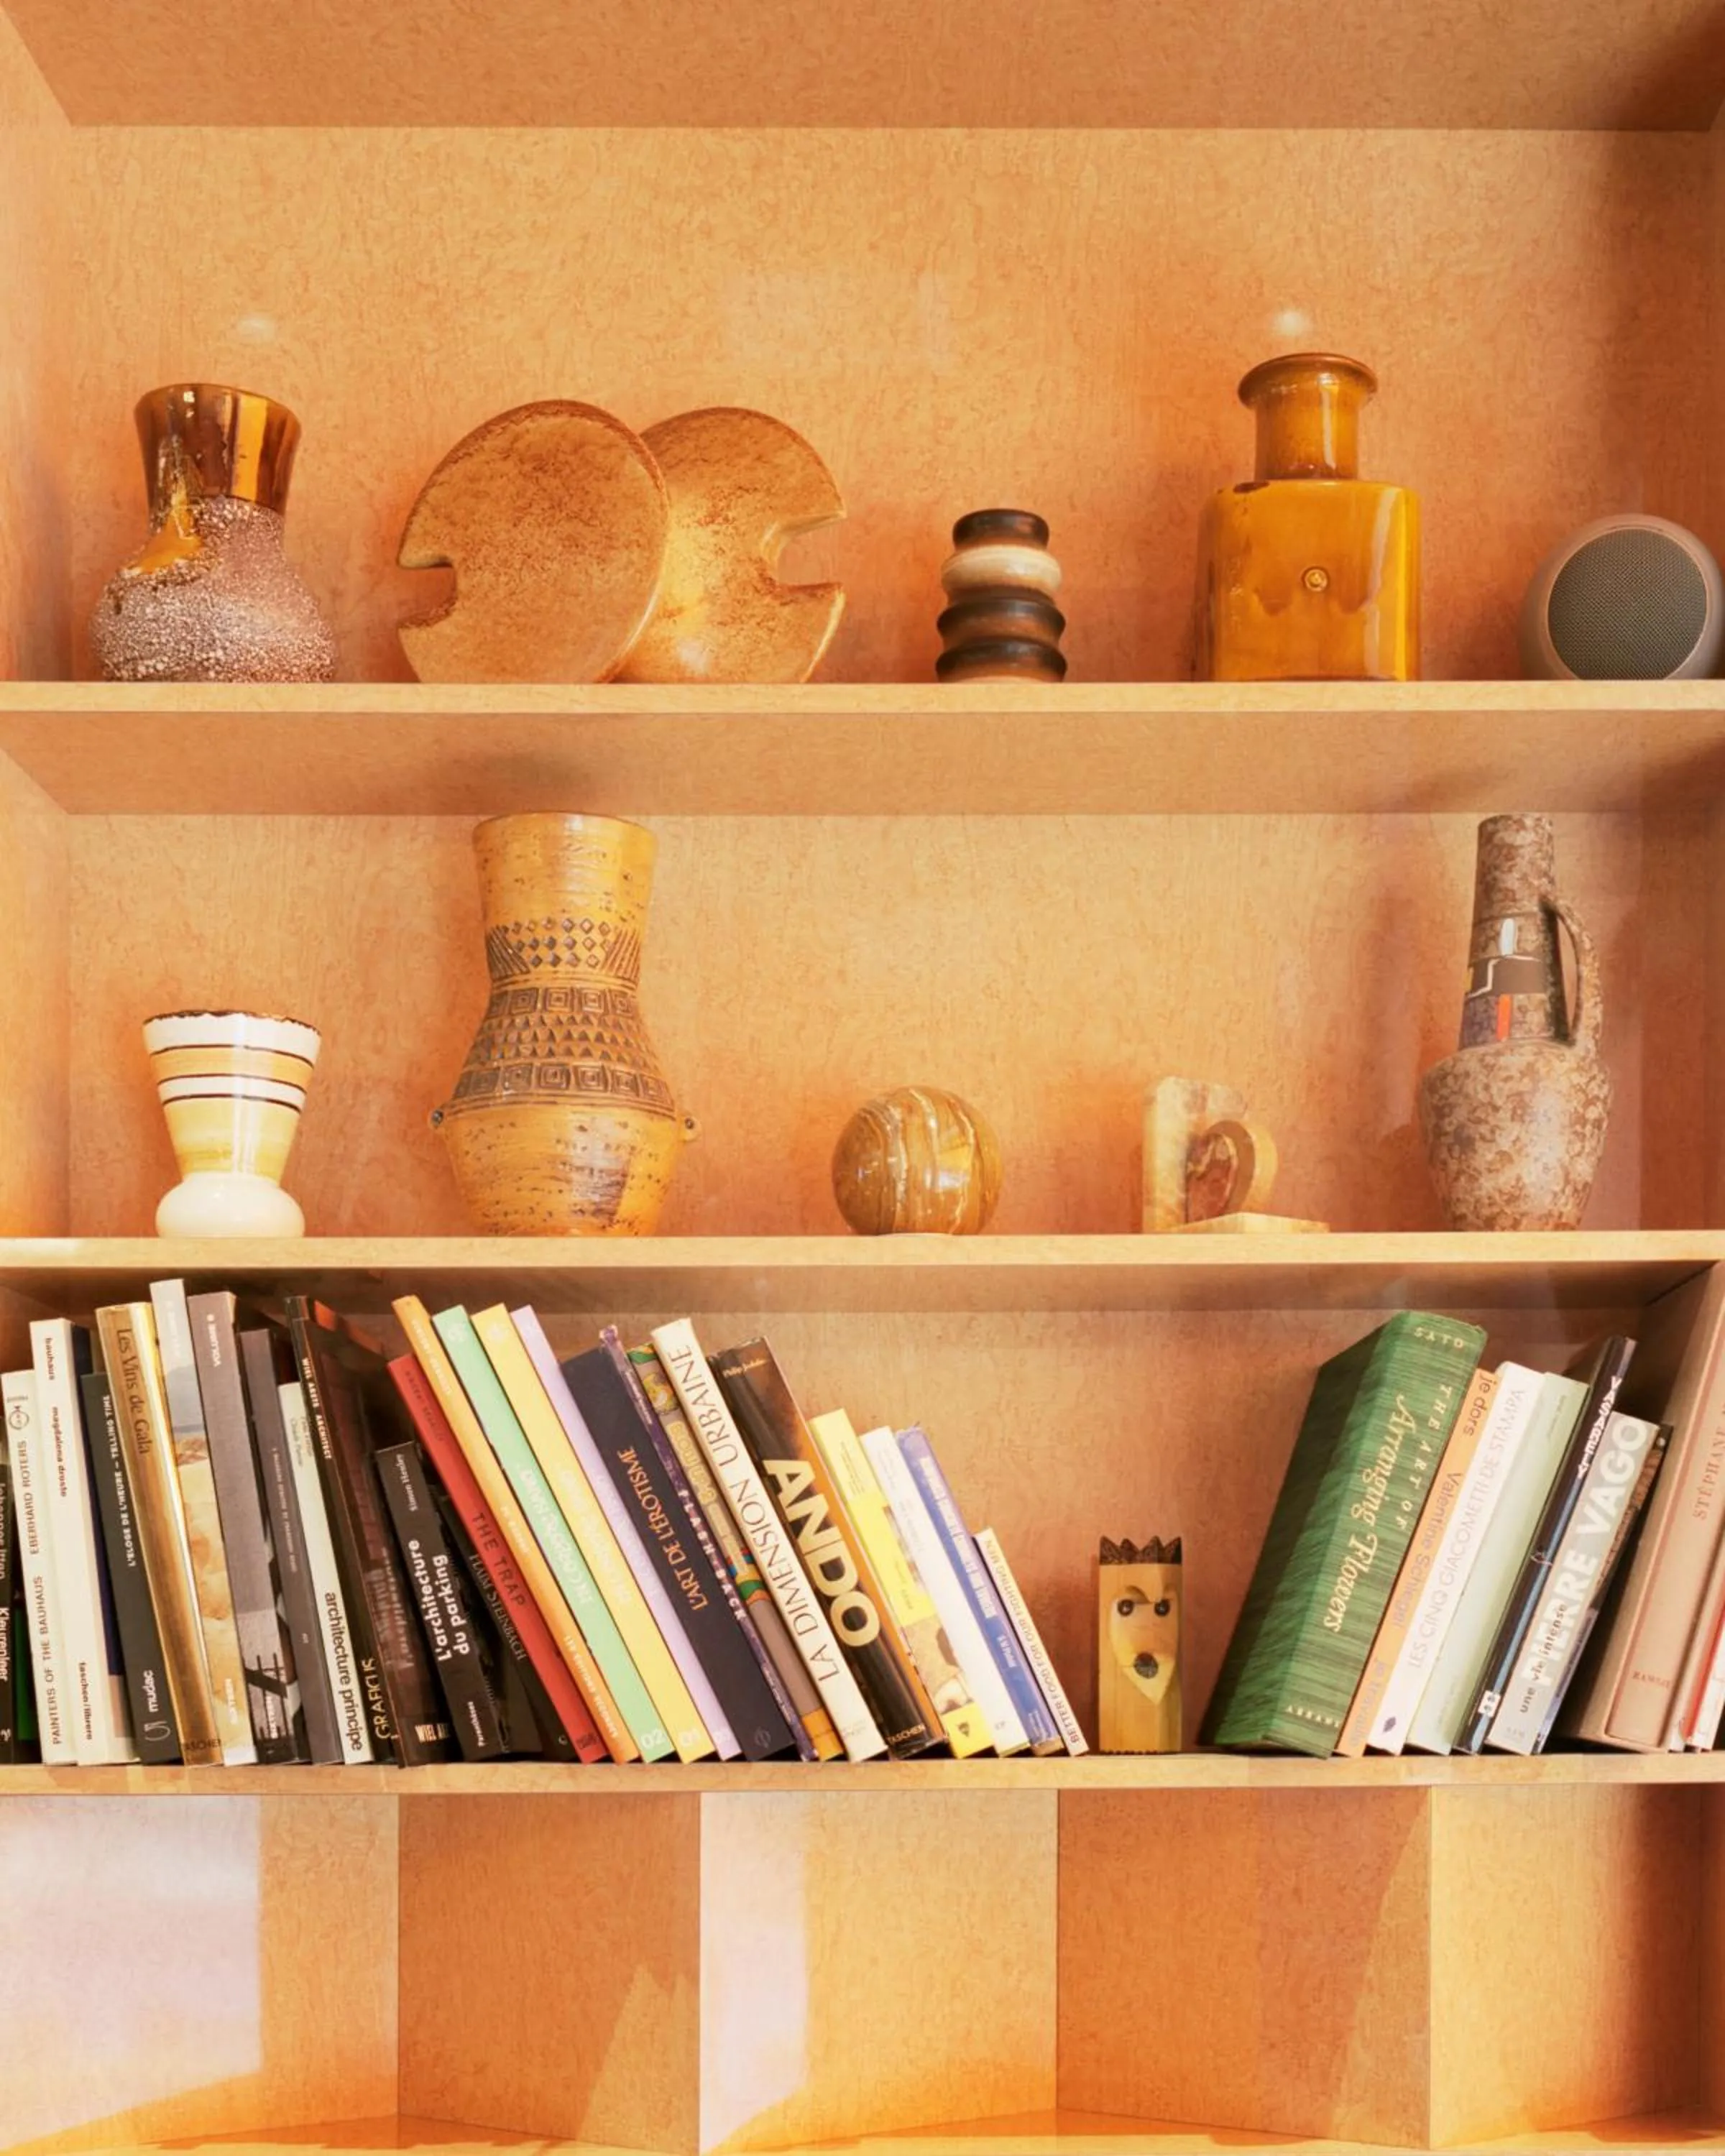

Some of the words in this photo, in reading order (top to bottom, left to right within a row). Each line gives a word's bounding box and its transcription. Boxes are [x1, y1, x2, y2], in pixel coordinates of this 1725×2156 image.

[43, 1337, 58, 1381] bauhaus
[116, 1327, 135, 1353] Les
[1413, 1327, 1463, 1348] SATO
[121, 1355, 143, 1390] Vins
[1475, 1375, 1496, 1395] je
[101, 1394, 114, 1416] TIME
[128, 1393, 146, 1414] de
[666, 1343, 741, 1468] URBAINE
[1425, 1383, 1454, 1432] THE
[1462, 1396, 1489, 1438] dors
[1485, 1384, 1527, 1454] STAMPA
[1573, 1374, 1622, 1480] VASARELY
[48, 1406, 65, 1462] magdalena
[104, 1419, 120, 1458] TELLING
[132, 1417, 155, 1455] Gala
[314, 1413, 334, 1460] ARCHITECT
[17, 1439, 31, 1488] ROTERS
[1347, 1393, 1425, 1527] Arranging
[1406, 1439, 1435, 1490] ART
[1477, 1452, 1500, 1480] DE
[615, 1443, 675, 1542] L'ÉROTISME
[1392, 1498, 1414, 1530] OF
[1419, 1468, 1463, 1552] Valentine
[23, 1492, 40, 1554] EBERHARD
[119, 1512, 129, 1525] DE
[470, 1511, 500, 1553] THE
[492, 1555, 527, 1608] TRAP
[661, 1539, 687, 1566] DE
[728, 1477, 819, 1637] DIMENSION
[763, 1460, 880, 1646] ANDO
[1519, 1547, 1598, 1690] PIERRE
[1574, 1411, 1653, 1544] VAGO
[33, 1575, 49, 1634] BAUHAUS
[404, 1538, 453, 1662] L'architecture
[427, 1553, 466, 1628] parking
[671, 1562, 710, 1612] L'ART
[1319, 1527, 1381, 1634] Flowers
[486, 1589, 527, 1661] STEINBACH
[1018, 1616, 1035, 1642] OUR
[1416, 1587, 1451, 1640] CINQ
[40, 1639, 52, 1660] THE
[450, 1630, 470, 1656] du
[805, 1643, 841, 1683] LA
[1029, 1642, 1046, 1667] FOR
[1405, 1640, 1429, 1669] LES
[1515, 1685, 1537, 1714] une
[1527, 1658, 1547, 1682] vie
[1537, 1601, 1570, 1657] intense
[43, 1666, 55, 1682] OF
[139, 1669, 160, 1713] mudac
[322, 1590, 354, 1687] architecture
[338, 1687, 364, 1752] principe
[1039, 1667, 1060, 1700] FOOD
[46, 1687, 62, 1745] PAINTERS
[1054, 1700, 1080, 1743] BETTER
